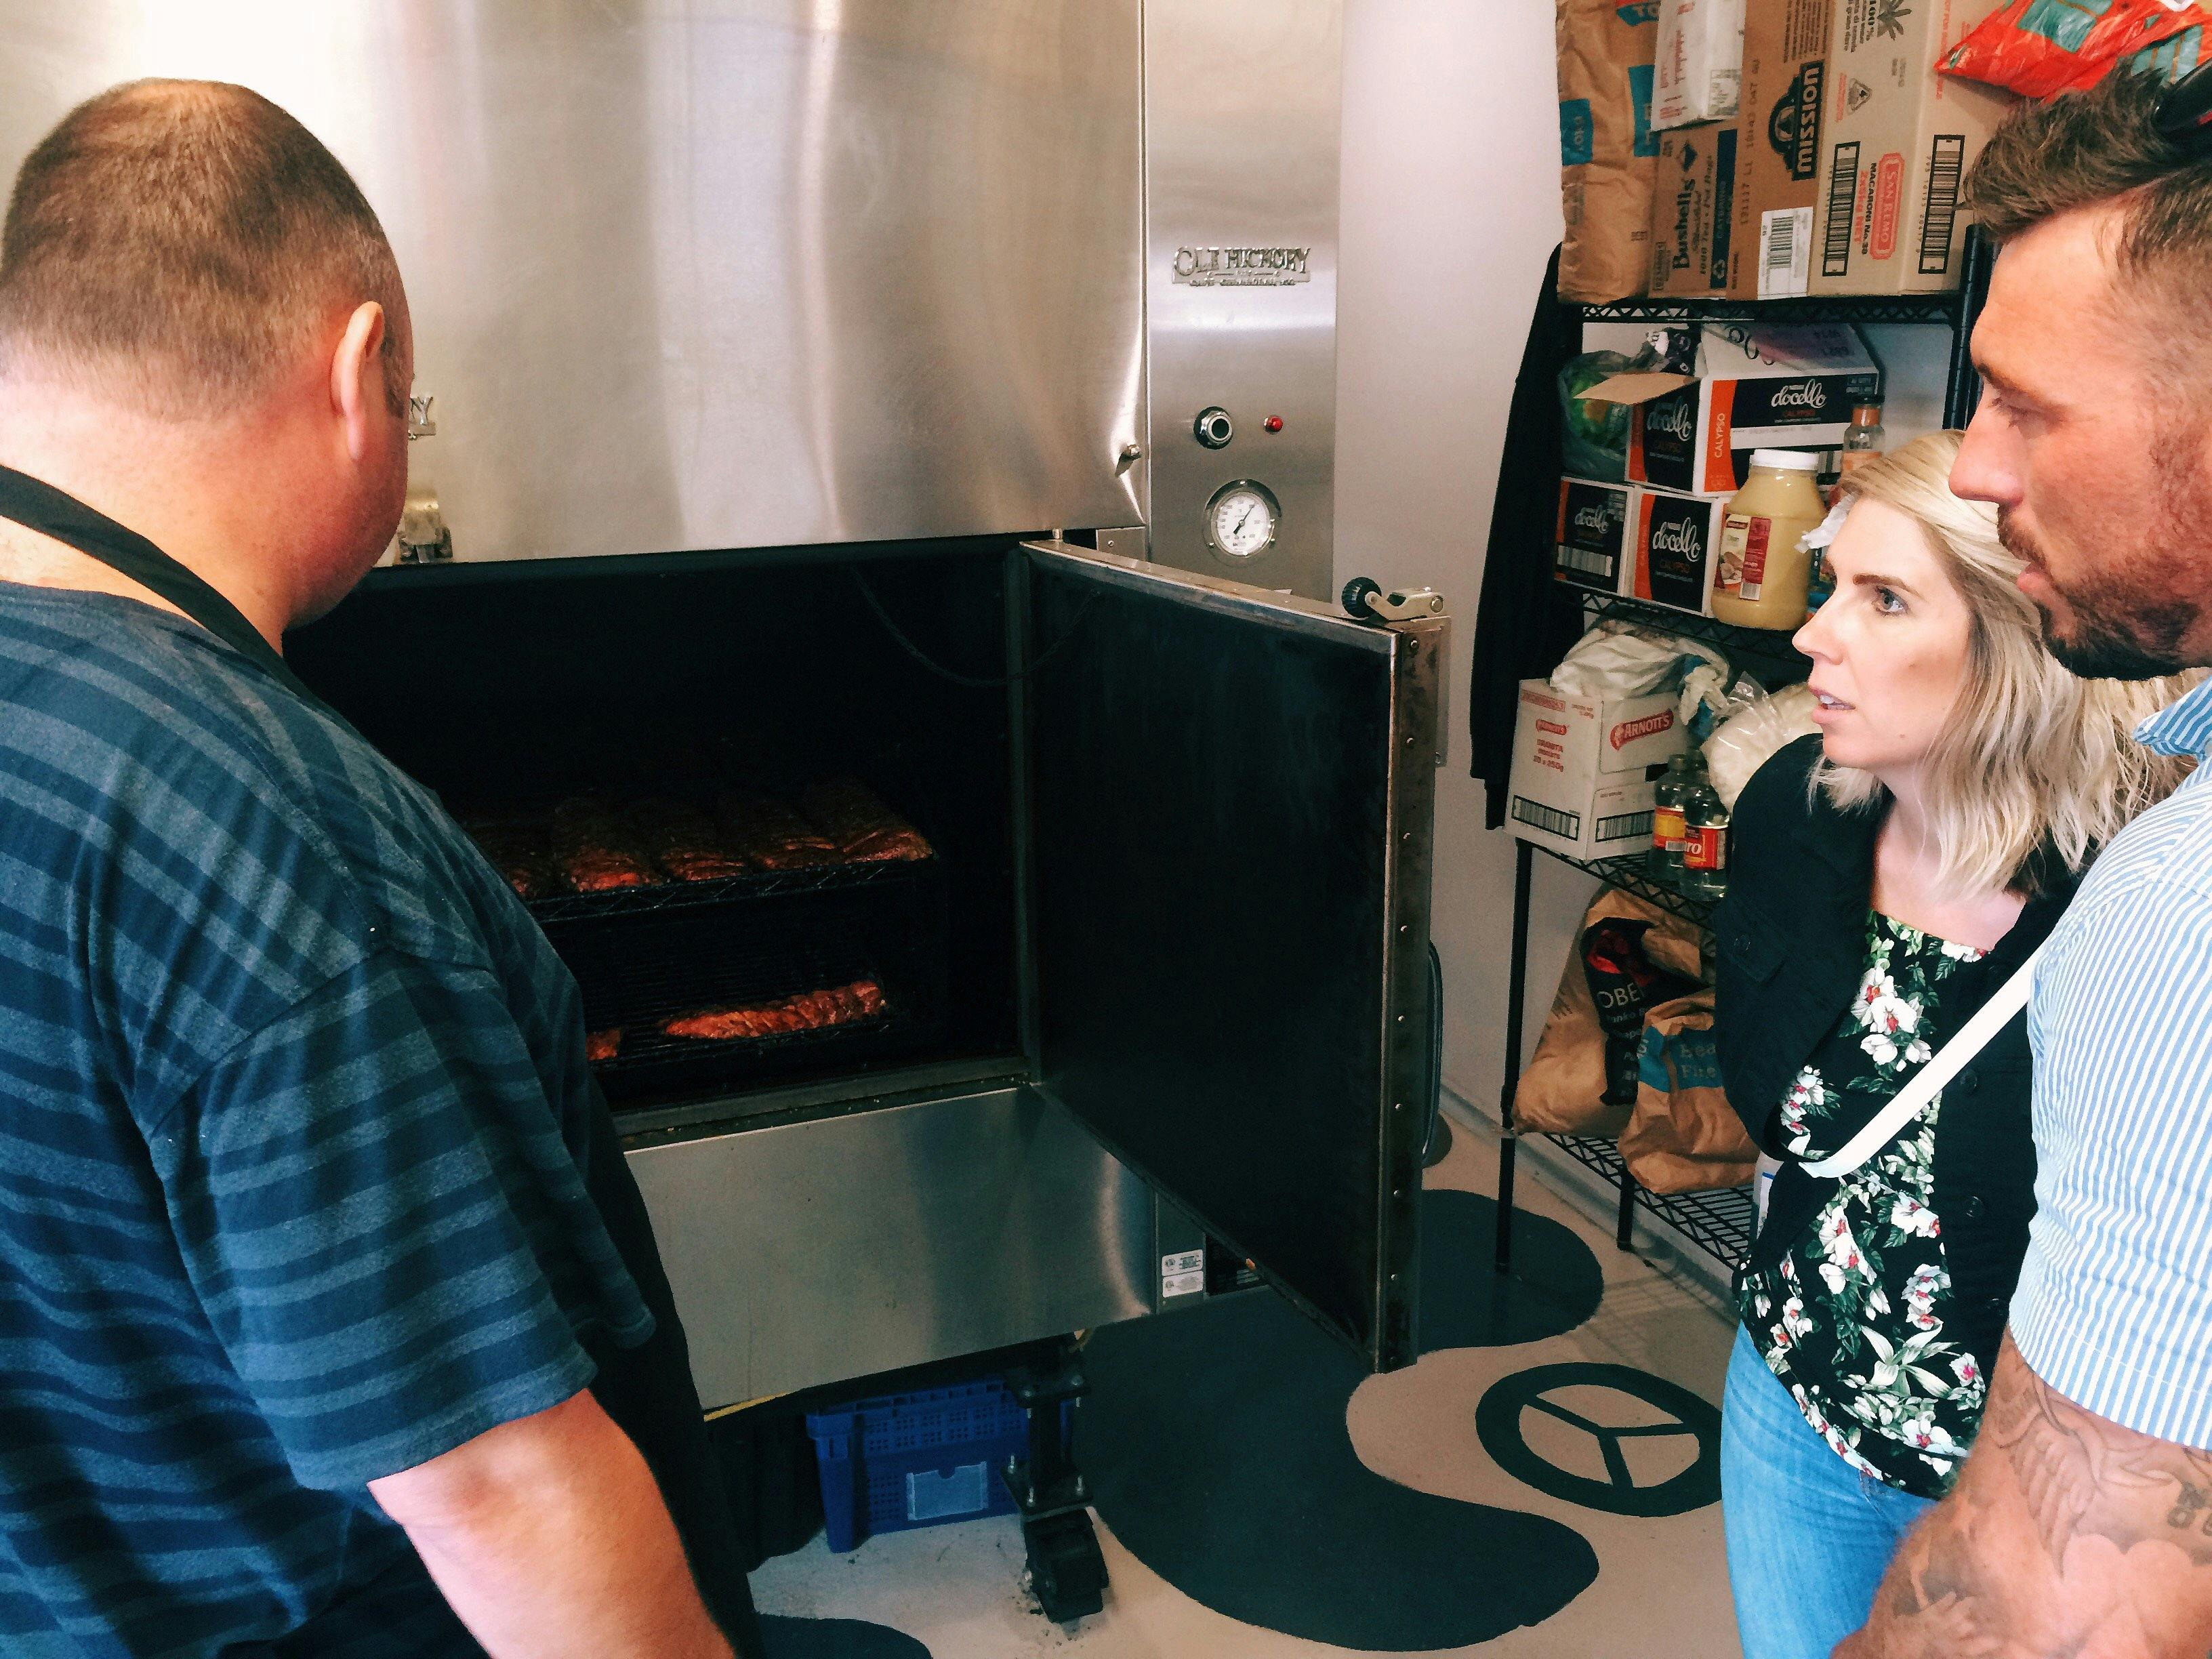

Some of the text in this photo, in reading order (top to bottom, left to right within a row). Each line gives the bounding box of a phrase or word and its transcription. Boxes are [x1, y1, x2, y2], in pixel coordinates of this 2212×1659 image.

[1865, 163, 1877, 222] MACARONI
[1881, 171, 1896, 243] SAN REMO
[1673, 179, 1696, 270] Bushells
[1224, 247, 1311, 274] HICKORY
[1771, 378, 1827, 409] docello
[1715, 413, 1725, 458] CALYPSO
[1652, 516, 1702, 562] docello
